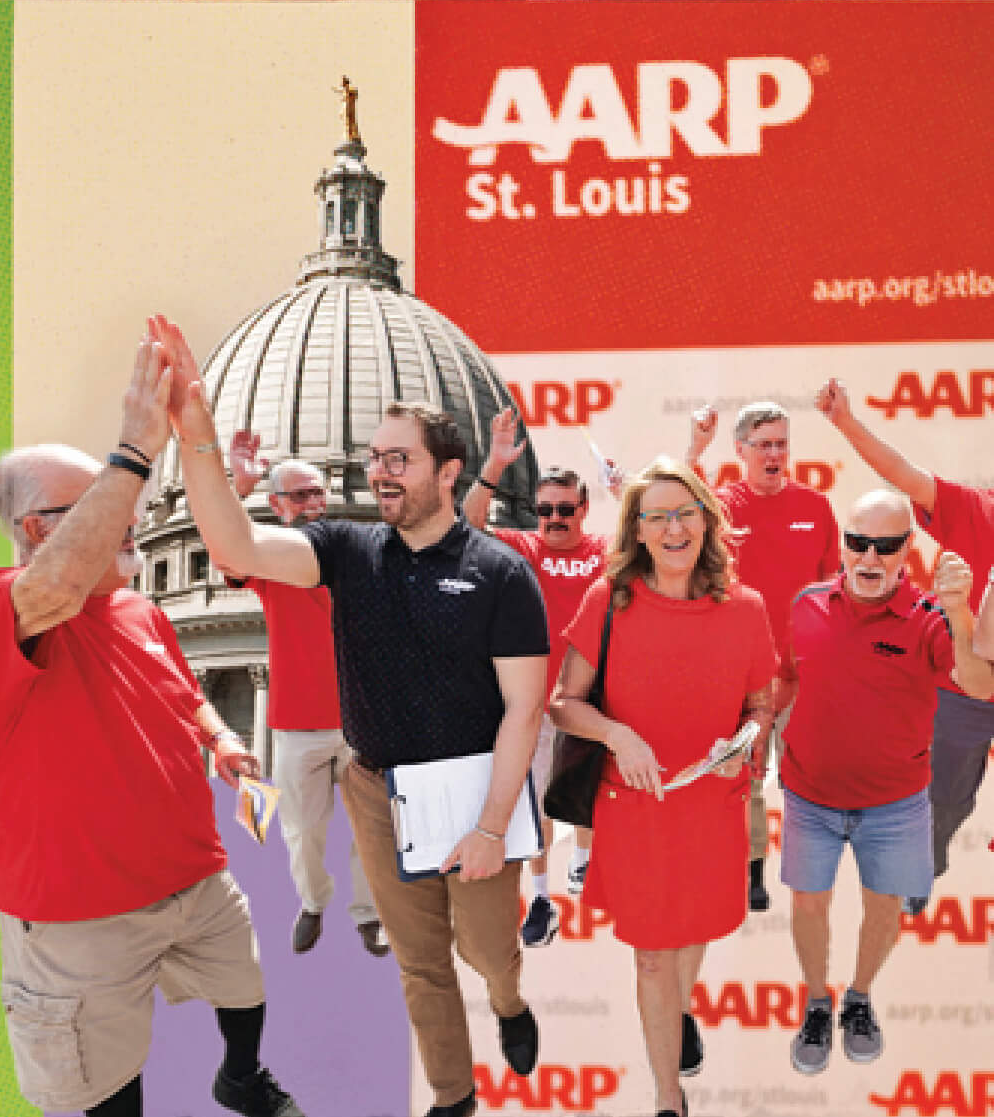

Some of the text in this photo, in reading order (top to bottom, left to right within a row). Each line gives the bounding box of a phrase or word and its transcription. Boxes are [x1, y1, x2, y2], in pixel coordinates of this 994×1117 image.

[432, 56, 813, 165] AARP
[467, 162, 691, 221] St. Louis
[690, 982, 836, 1027] AAR
